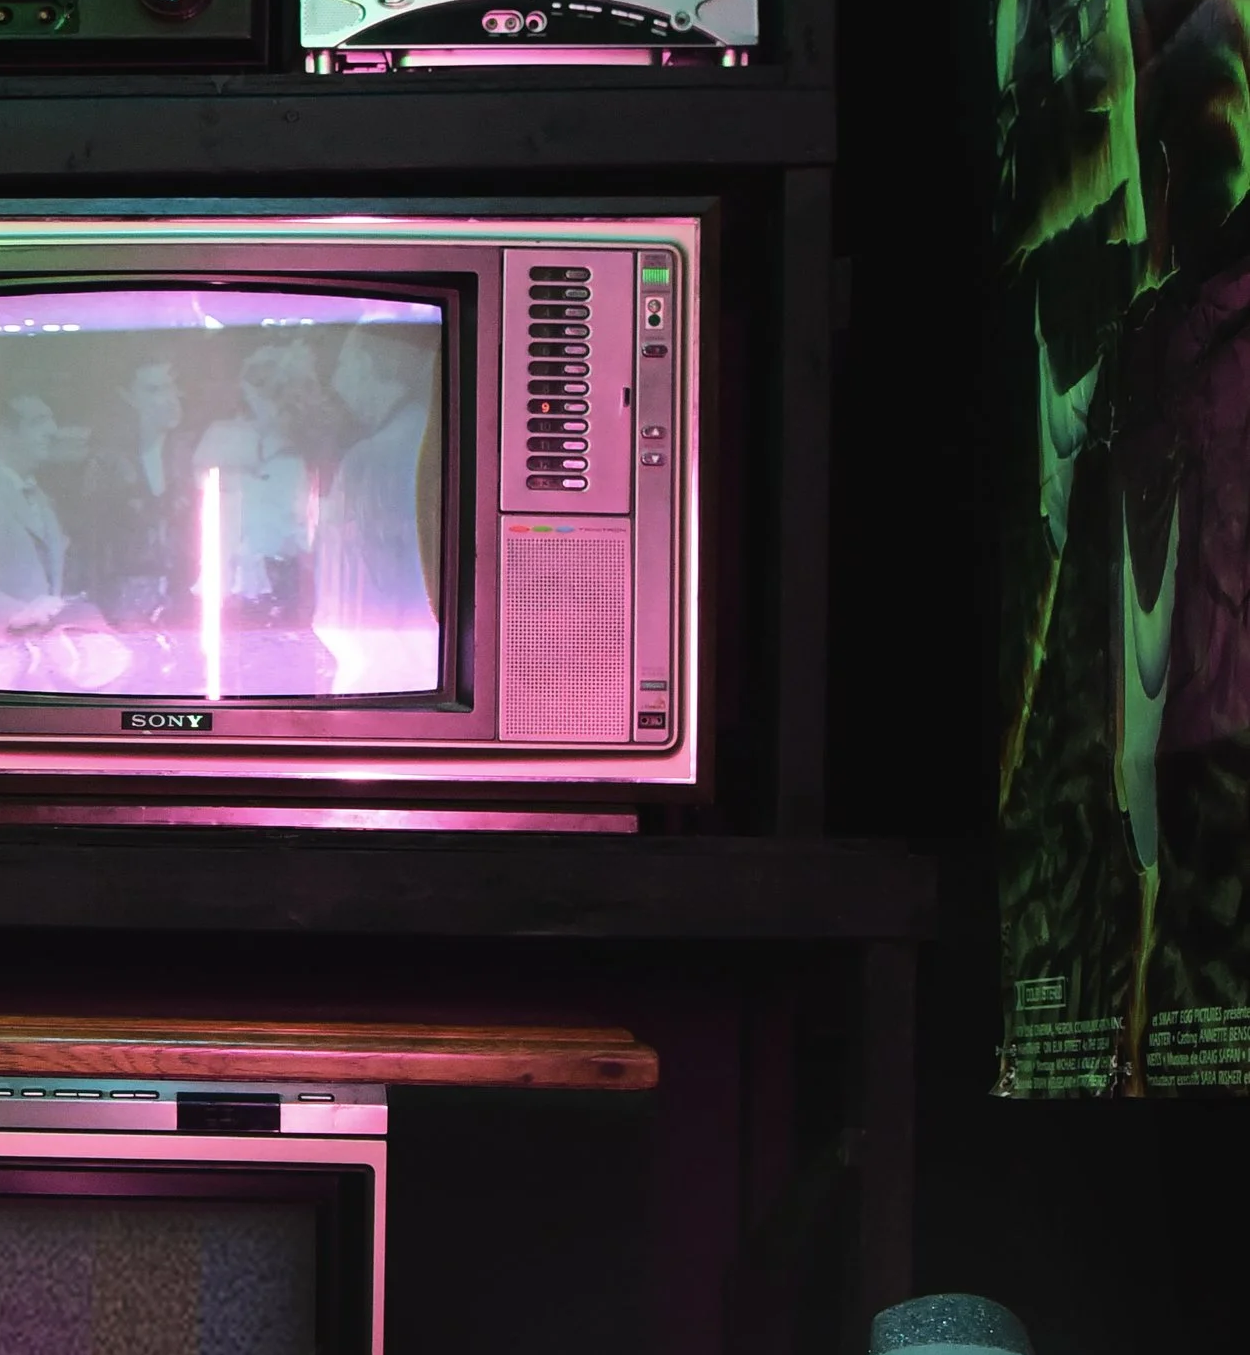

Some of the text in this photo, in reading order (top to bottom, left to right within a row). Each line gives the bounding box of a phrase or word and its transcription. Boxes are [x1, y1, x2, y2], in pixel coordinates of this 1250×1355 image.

[541, 402, 550, 413] 9
[131, 714, 204, 727] SONY
[1159, 1010, 1179, 1025] SMART
[1180, 1009, 1193, 1024] EGG
[1194, 1007, 1222, 1022] PICTURES
[1149, 1032, 1171, 1046] MASTER
[1200, 1027, 1228, 1043] ANNETTE
[1190, 1051, 1198, 1064] de
[1199, 1049, 1218, 1065] CRAIG
[1219, 1047, 1241, 1063] SAFAN
[1201, 1070, 1216, 1085] SARA
[1218, 1069, 1242, 1085] RISHER
